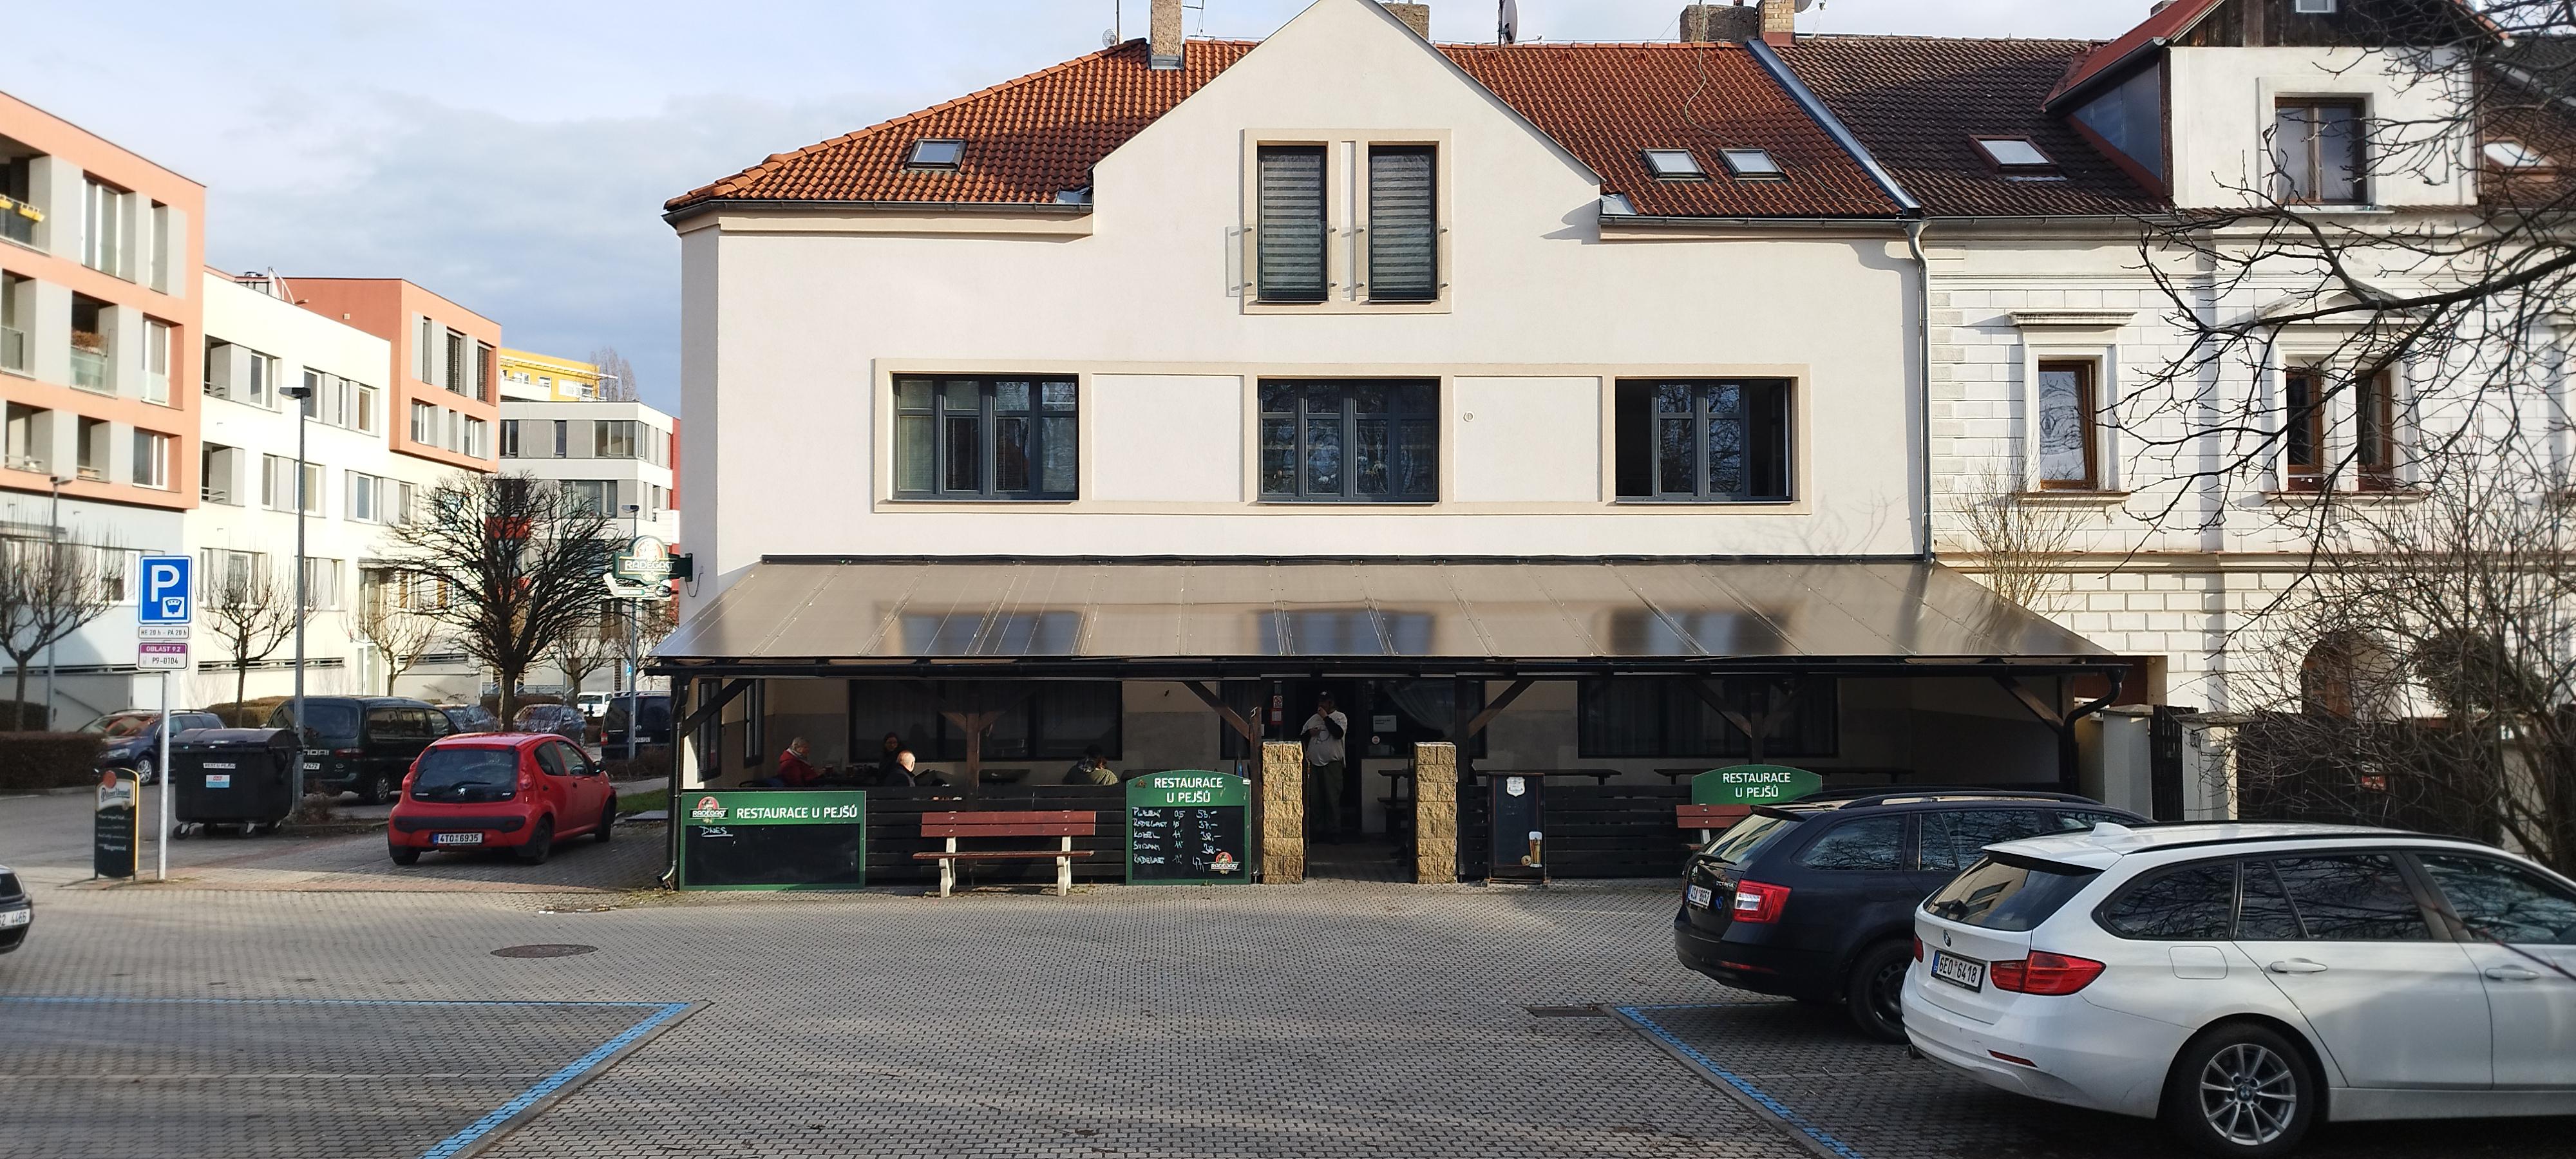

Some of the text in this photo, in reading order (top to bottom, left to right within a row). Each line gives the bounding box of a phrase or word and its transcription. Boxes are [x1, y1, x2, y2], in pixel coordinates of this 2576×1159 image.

[625, 560, 674, 572] RADEGAST
[151, 565, 180, 602] P
[1155, 777, 1223, 788] RESTAURACE
[1723, 773, 1791, 783] RESTAURACE
[1166, 792, 1174, 803] U
[1735, 787, 1743, 797] U
[736, 807, 808, 818] RESTAURACE
[811, 807, 820, 818] U
[699, 826, 728, 836] DNES
[459, 834, 478, 842] 6935
[1956, 962, 1978, 983] 6418
